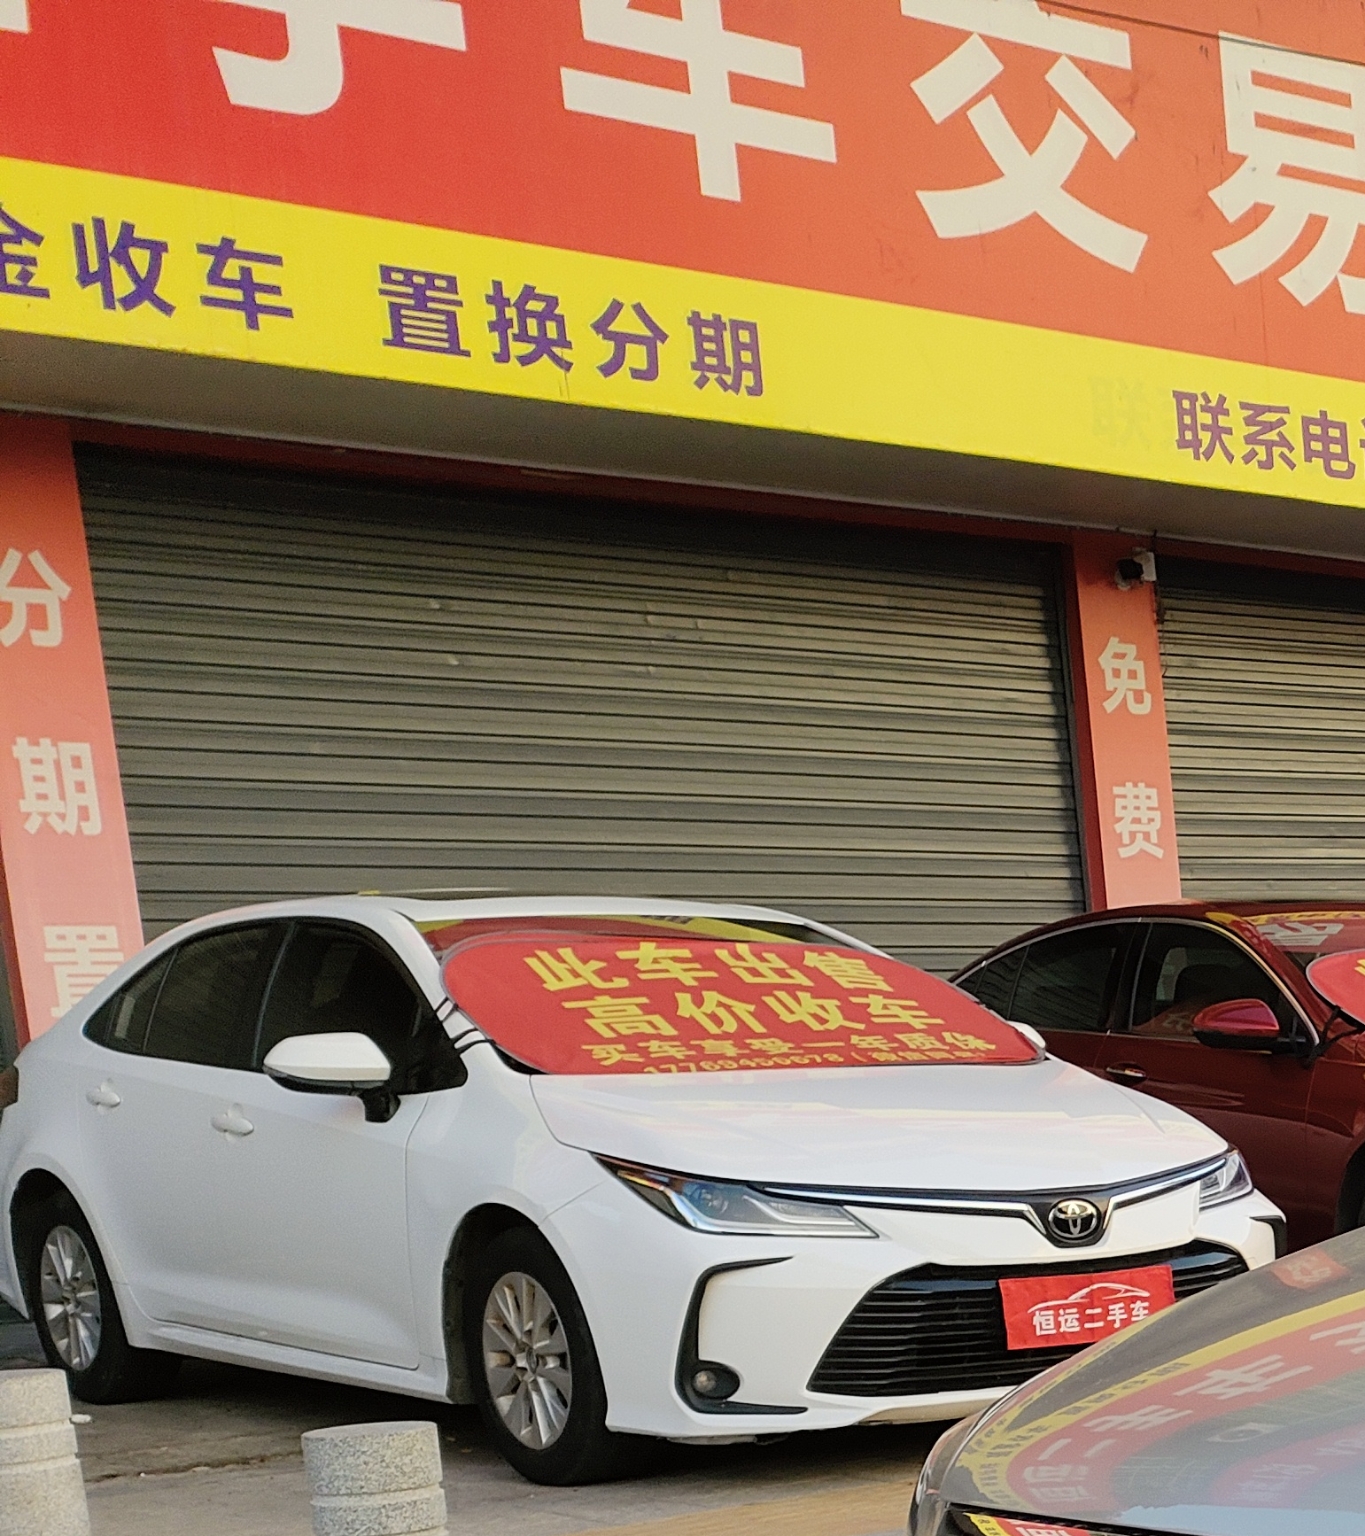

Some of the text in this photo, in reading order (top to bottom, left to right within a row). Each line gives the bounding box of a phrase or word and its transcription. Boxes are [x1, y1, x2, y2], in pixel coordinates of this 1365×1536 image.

[0, 208, 294, 331] 金收车
[376, 263, 765, 398] 置换分期
[1097, 636, 1164, 860] 免费
[523, 941, 894, 992] 此车出售
[561, 990, 946, 1038] 高价收车
[580, 1031, 997, 1066] 买车享受一年质保
[1032, 1300, 1150, 1337] 恒运二手车
